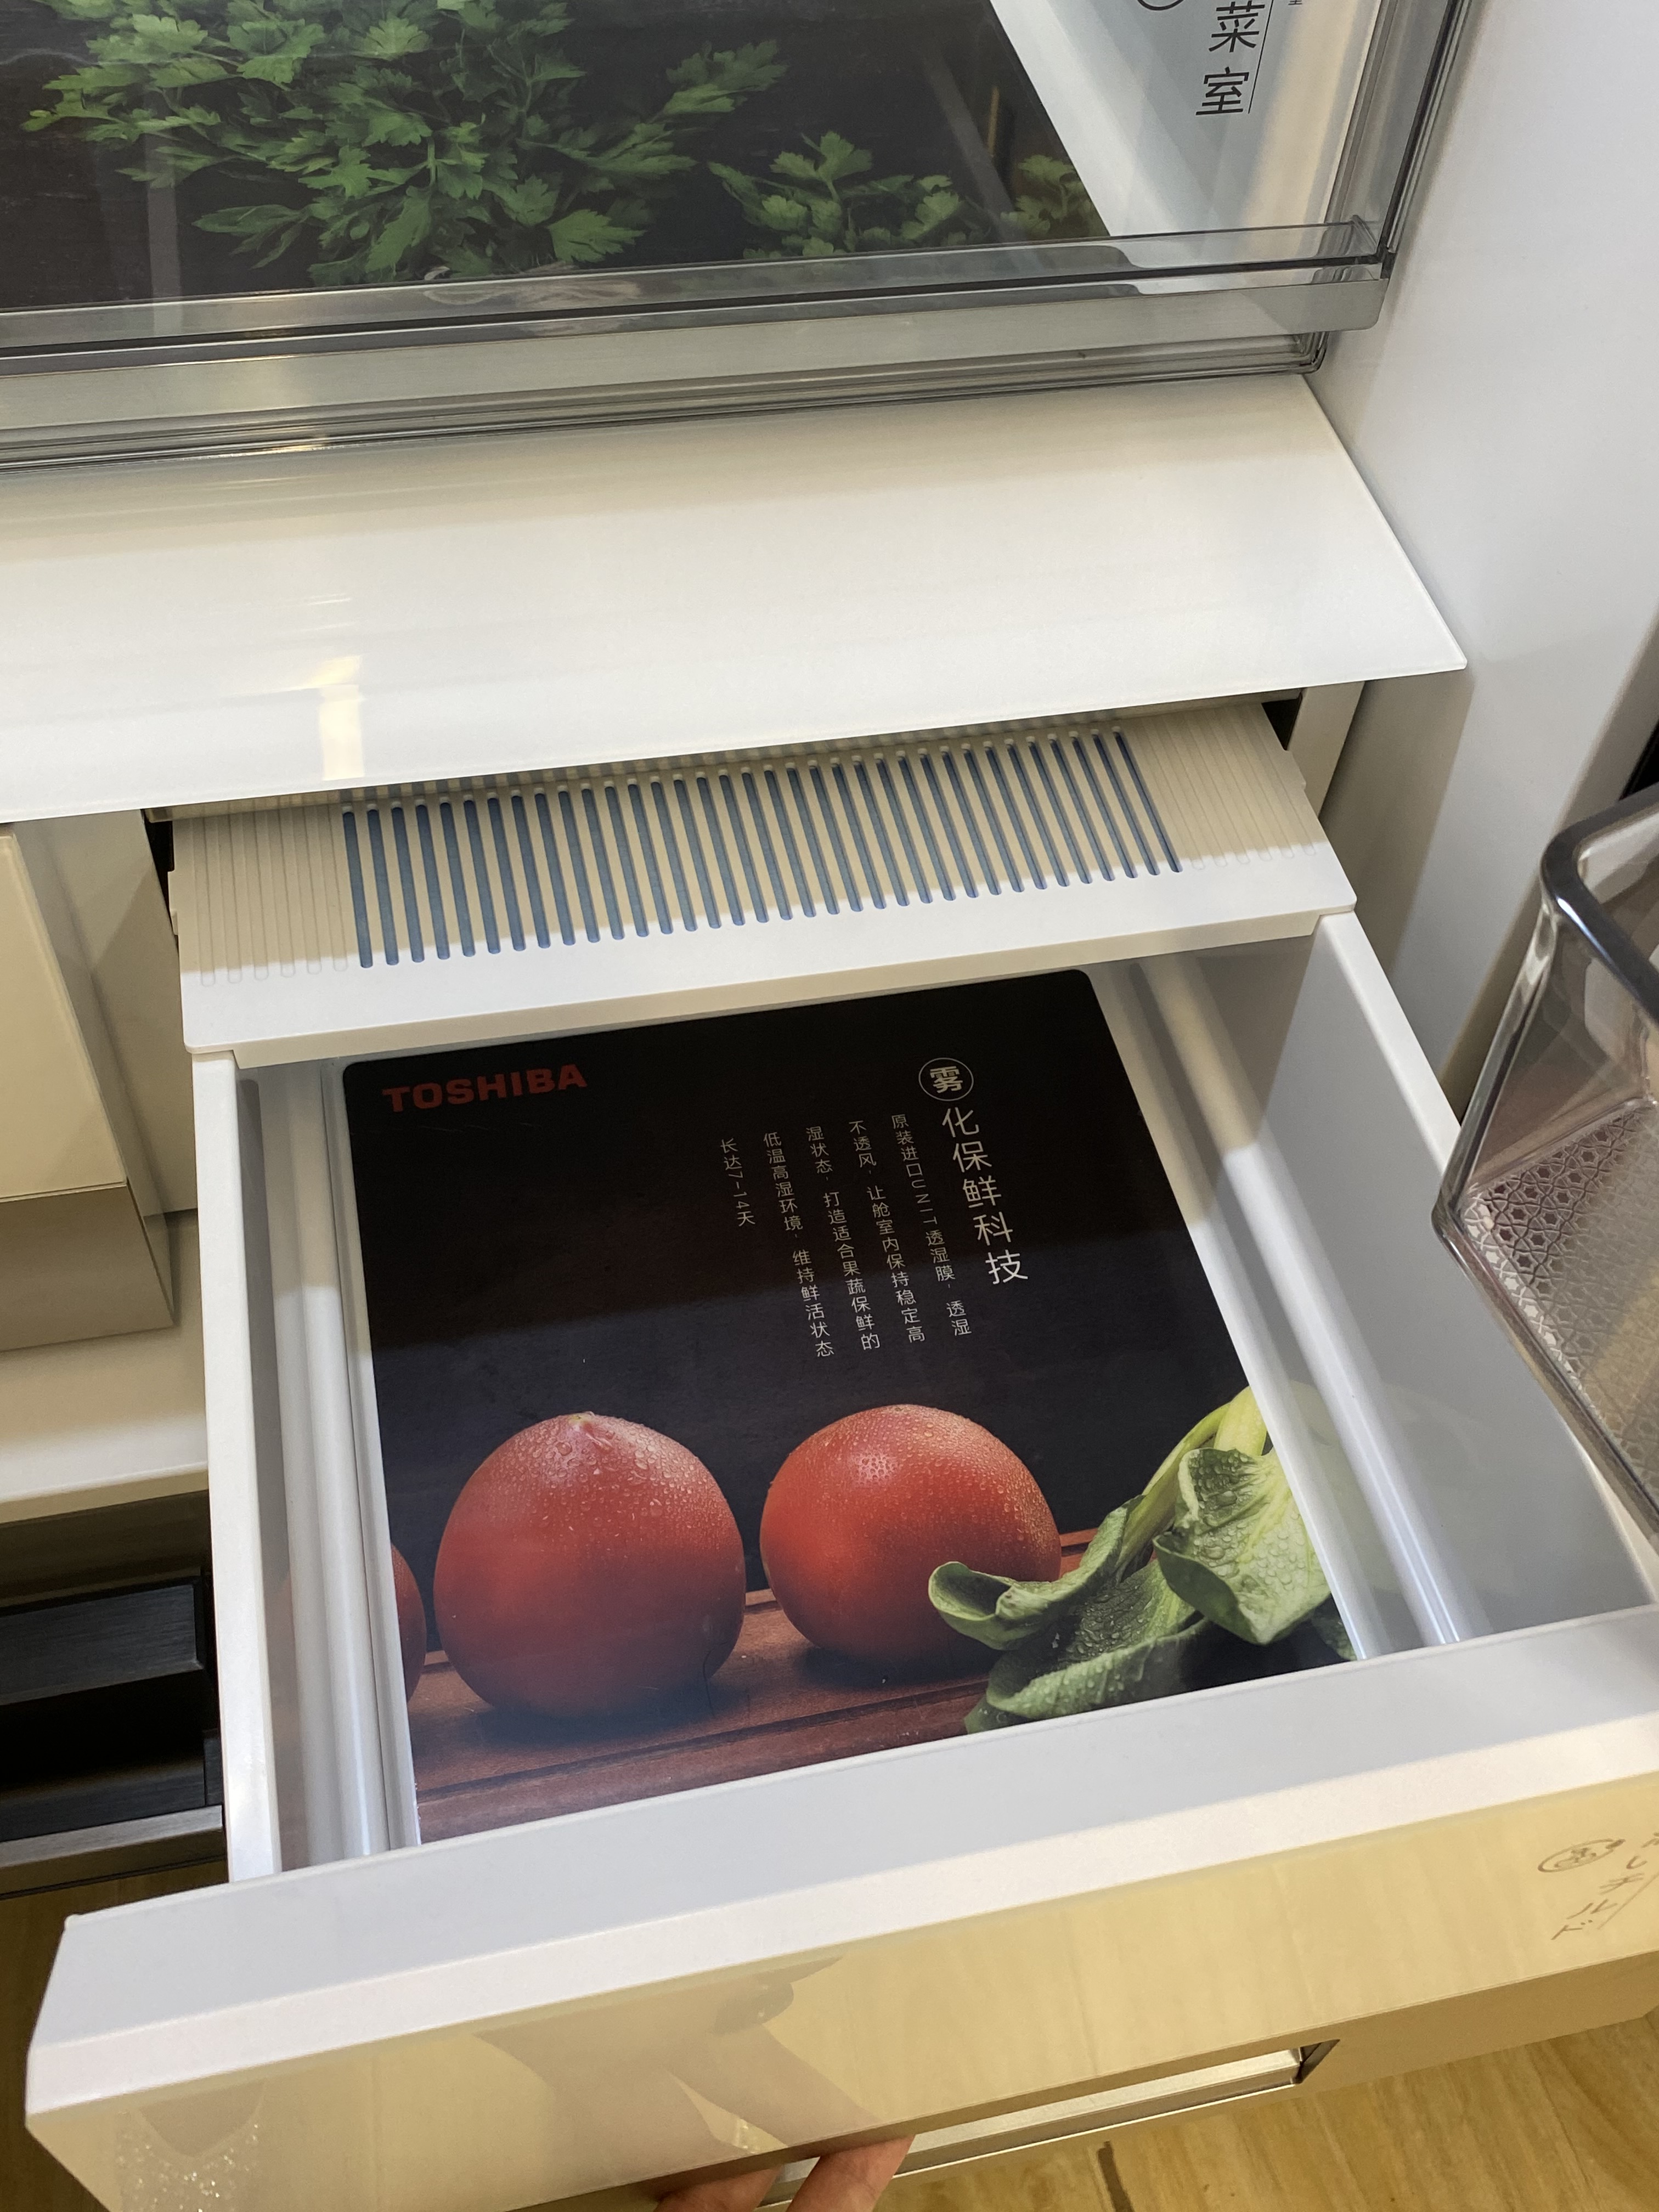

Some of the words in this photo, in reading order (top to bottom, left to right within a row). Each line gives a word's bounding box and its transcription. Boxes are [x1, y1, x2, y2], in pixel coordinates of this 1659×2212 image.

[382, 1064, 588, 1113] TOSHIBA
[720, 1138, 755, 1227] 长达7-14天
[928, 1065, 1029, 1284] 雾化保鲜科技
